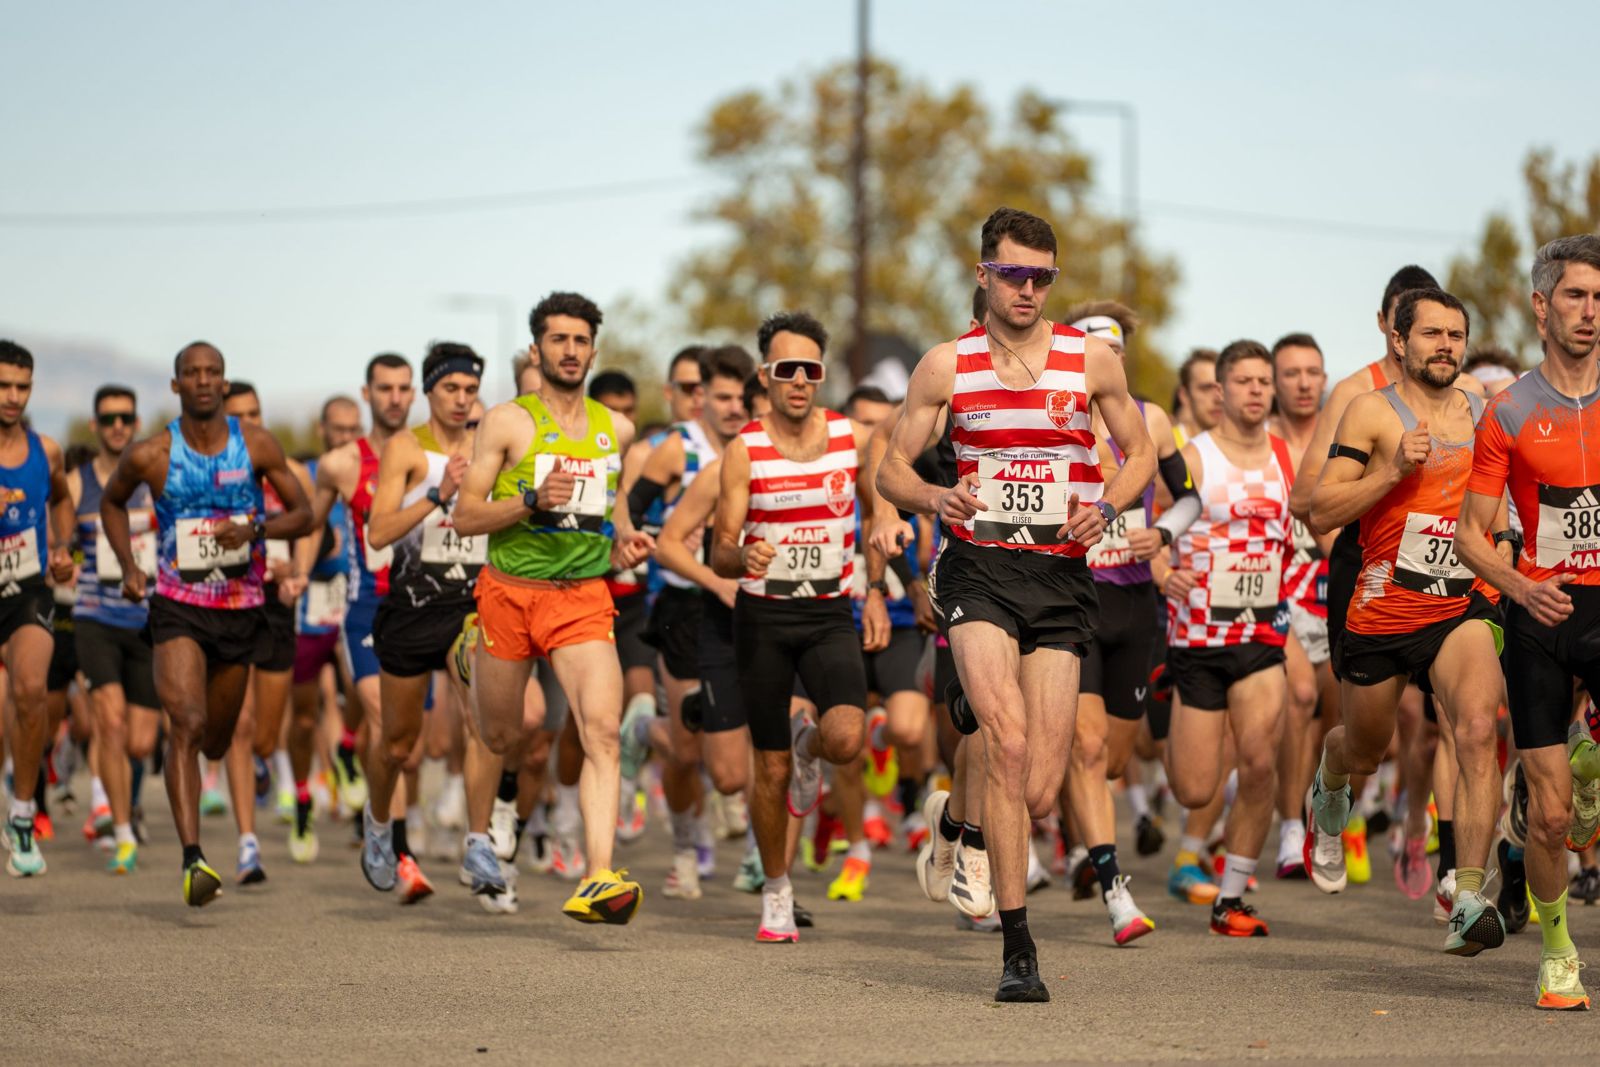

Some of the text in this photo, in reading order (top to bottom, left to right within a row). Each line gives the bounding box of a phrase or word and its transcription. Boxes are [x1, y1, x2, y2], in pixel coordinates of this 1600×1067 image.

[1003, 463, 1052, 480] MAIF
[1001, 482, 1044, 513] 353
[1012, 516, 1032, 524] ELISEO
[1103, 515, 1127, 539] 48
[1432, 519, 1457, 535] MA
[788, 528, 829, 544] MAIF
[198, 537, 226, 559] 53
[1571, 542, 1598, 551] AYMERIC
[787, 546, 821, 569] 379
[1236, 555, 1270, 571] MAIF
[1564, 552, 1600, 569] MAI
[1429, 568, 1451, 578] THOMAS
[1235, 573, 1263, 597] 419
